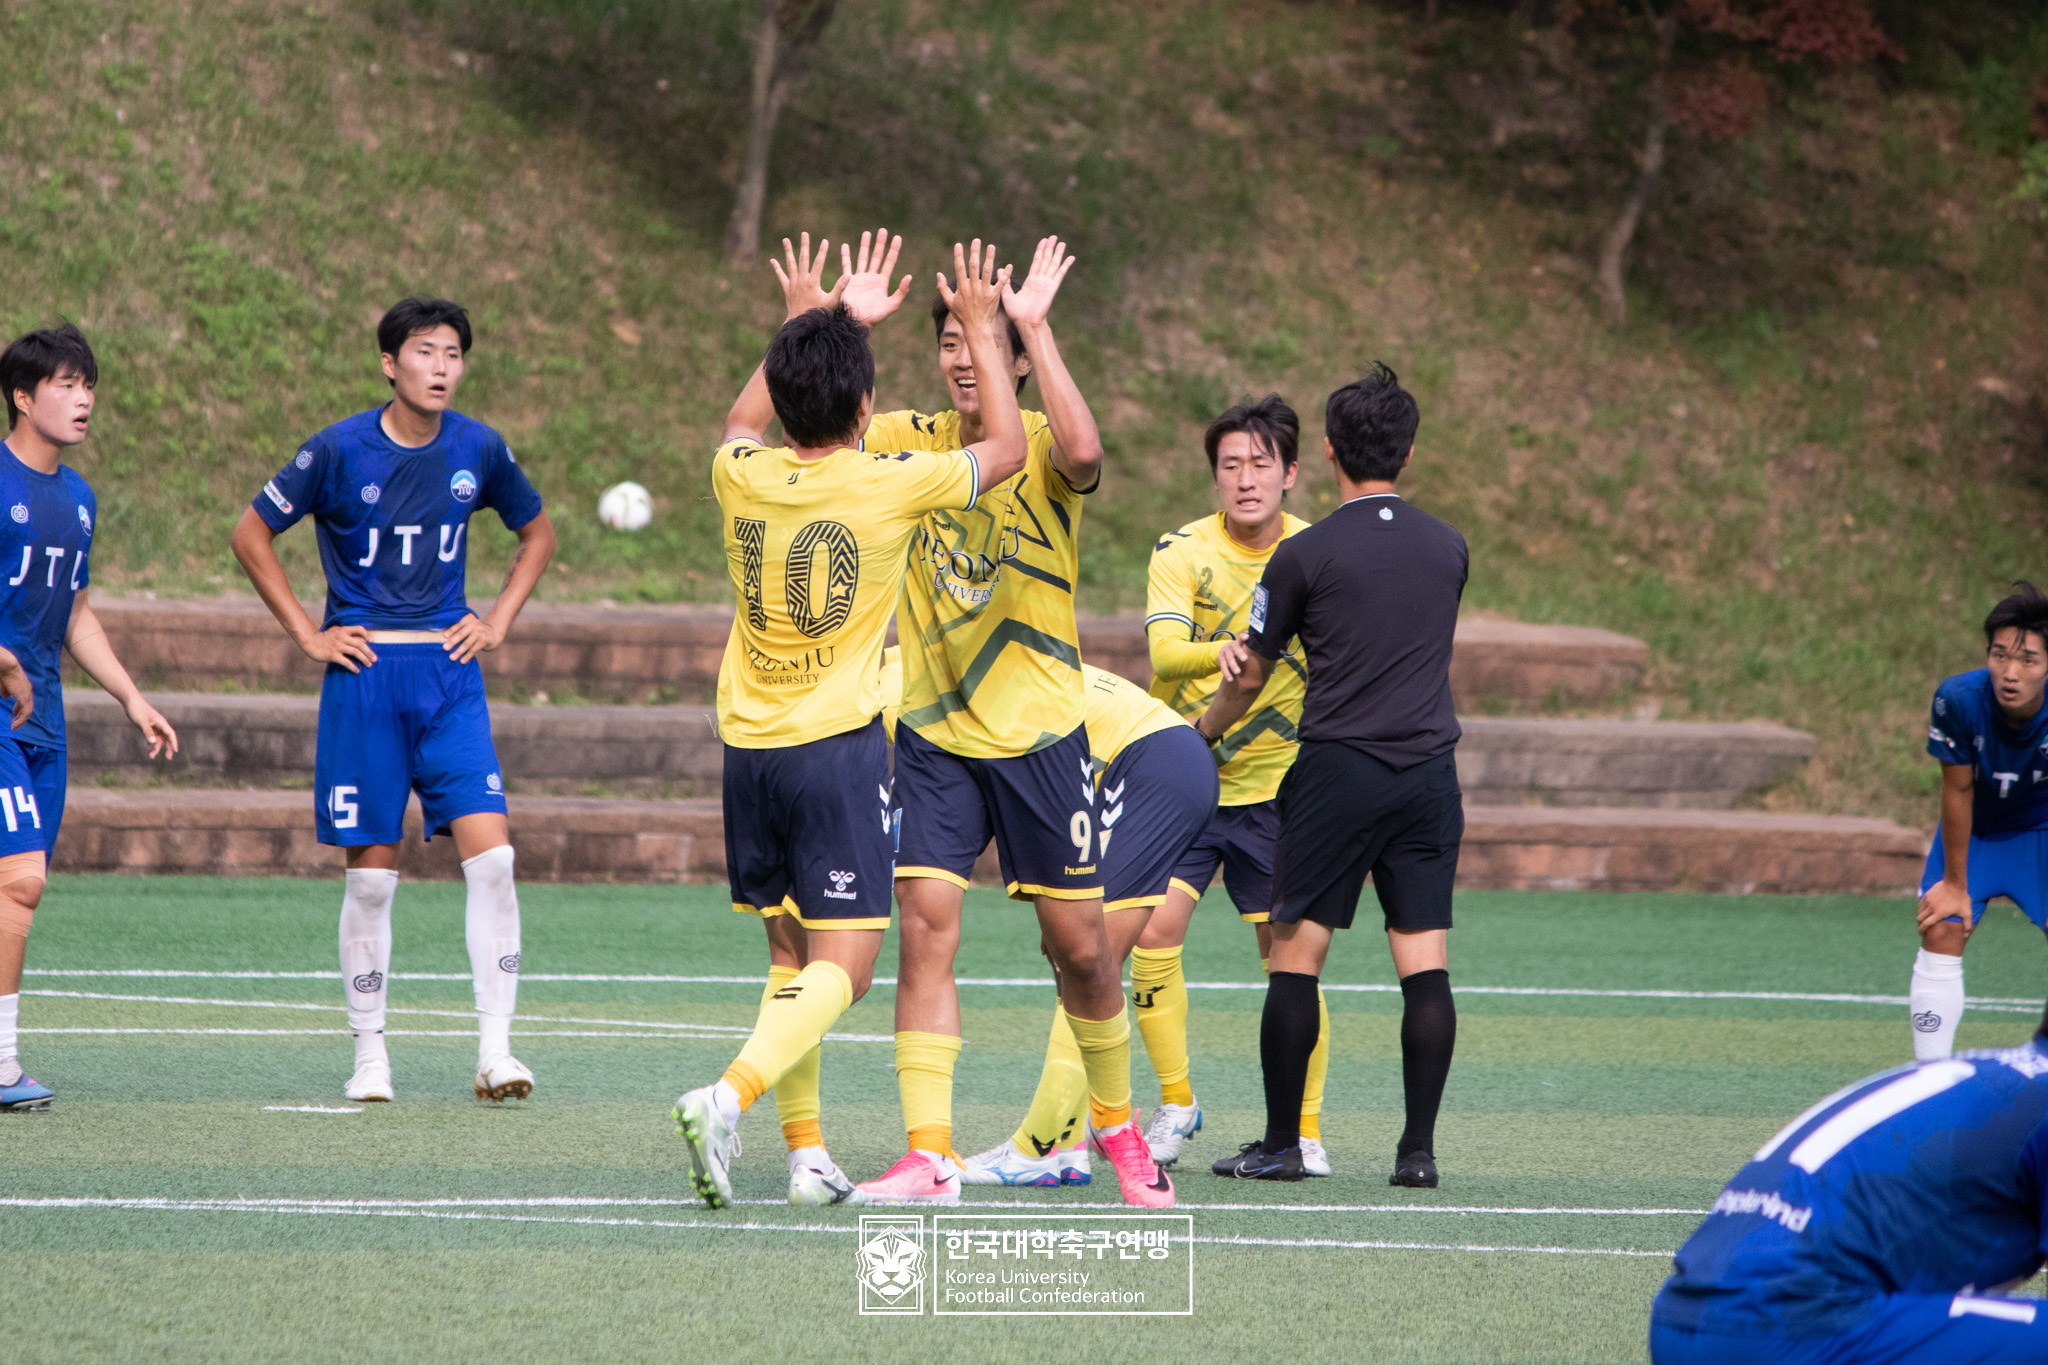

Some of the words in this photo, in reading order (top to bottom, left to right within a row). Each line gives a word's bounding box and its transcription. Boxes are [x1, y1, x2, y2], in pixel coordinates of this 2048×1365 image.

[359, 522, 465, 567] JTU
[920, 525, 1020, 583] JEONU
[734, 516, 859, 638] 10
[1195, 566, 1213, 600] 2
[756, 673, 820, 685] UNIVERSITY
[0, 786, 42, 832] 14
[328, 786, 358, 829] 5
[1069, 810, 1092, 863] 9
[1064, 863, 1097, 876] hummel
[824, 888, 857, 901] hummel
